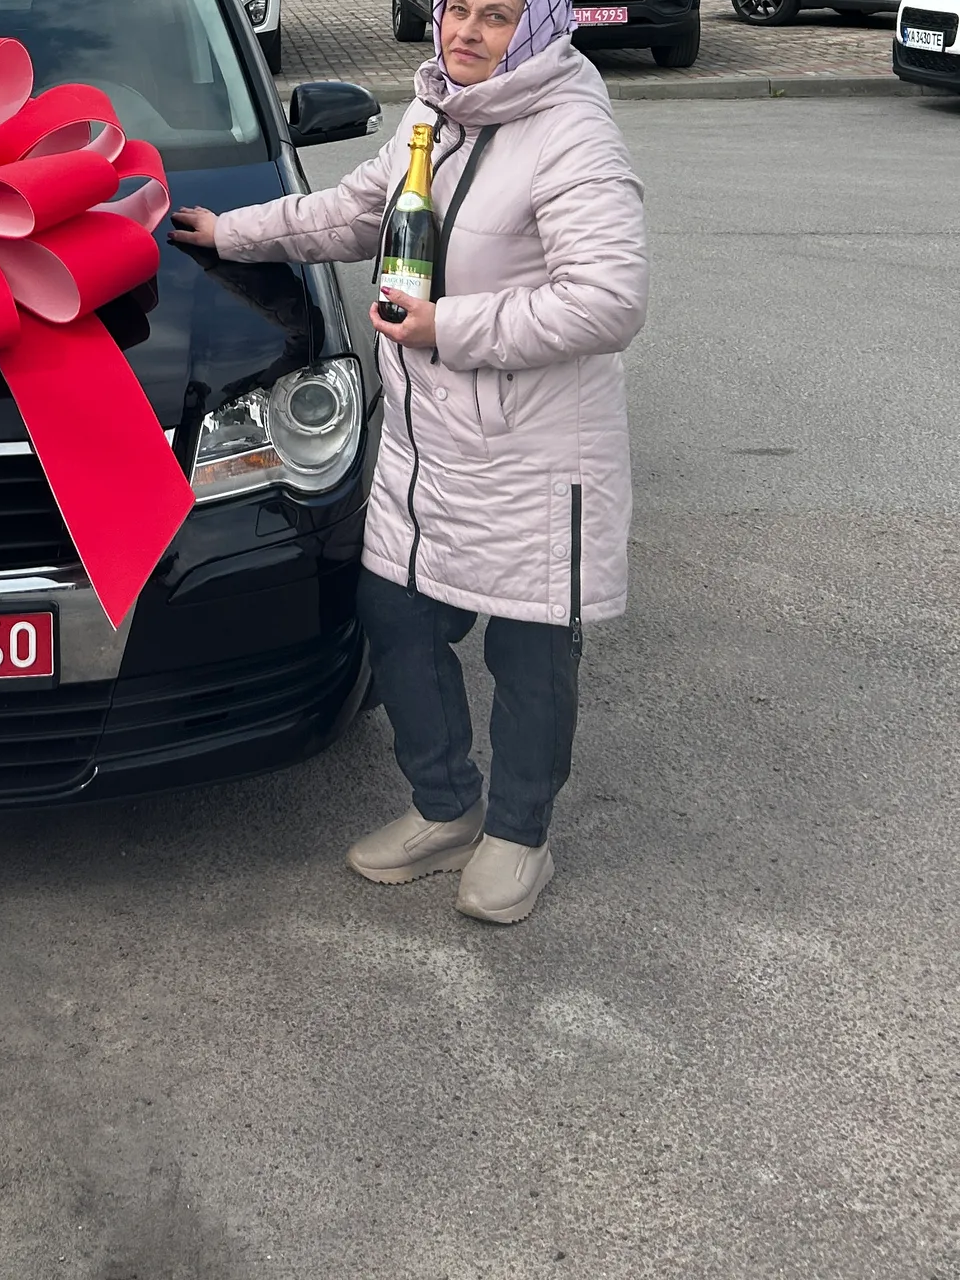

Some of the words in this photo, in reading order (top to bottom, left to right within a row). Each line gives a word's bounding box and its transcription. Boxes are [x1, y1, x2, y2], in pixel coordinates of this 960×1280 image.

[594, 9, 623, 21] 4995
[916, 31, 931, 45] 3430
[932, 33, 942, 47] TE
